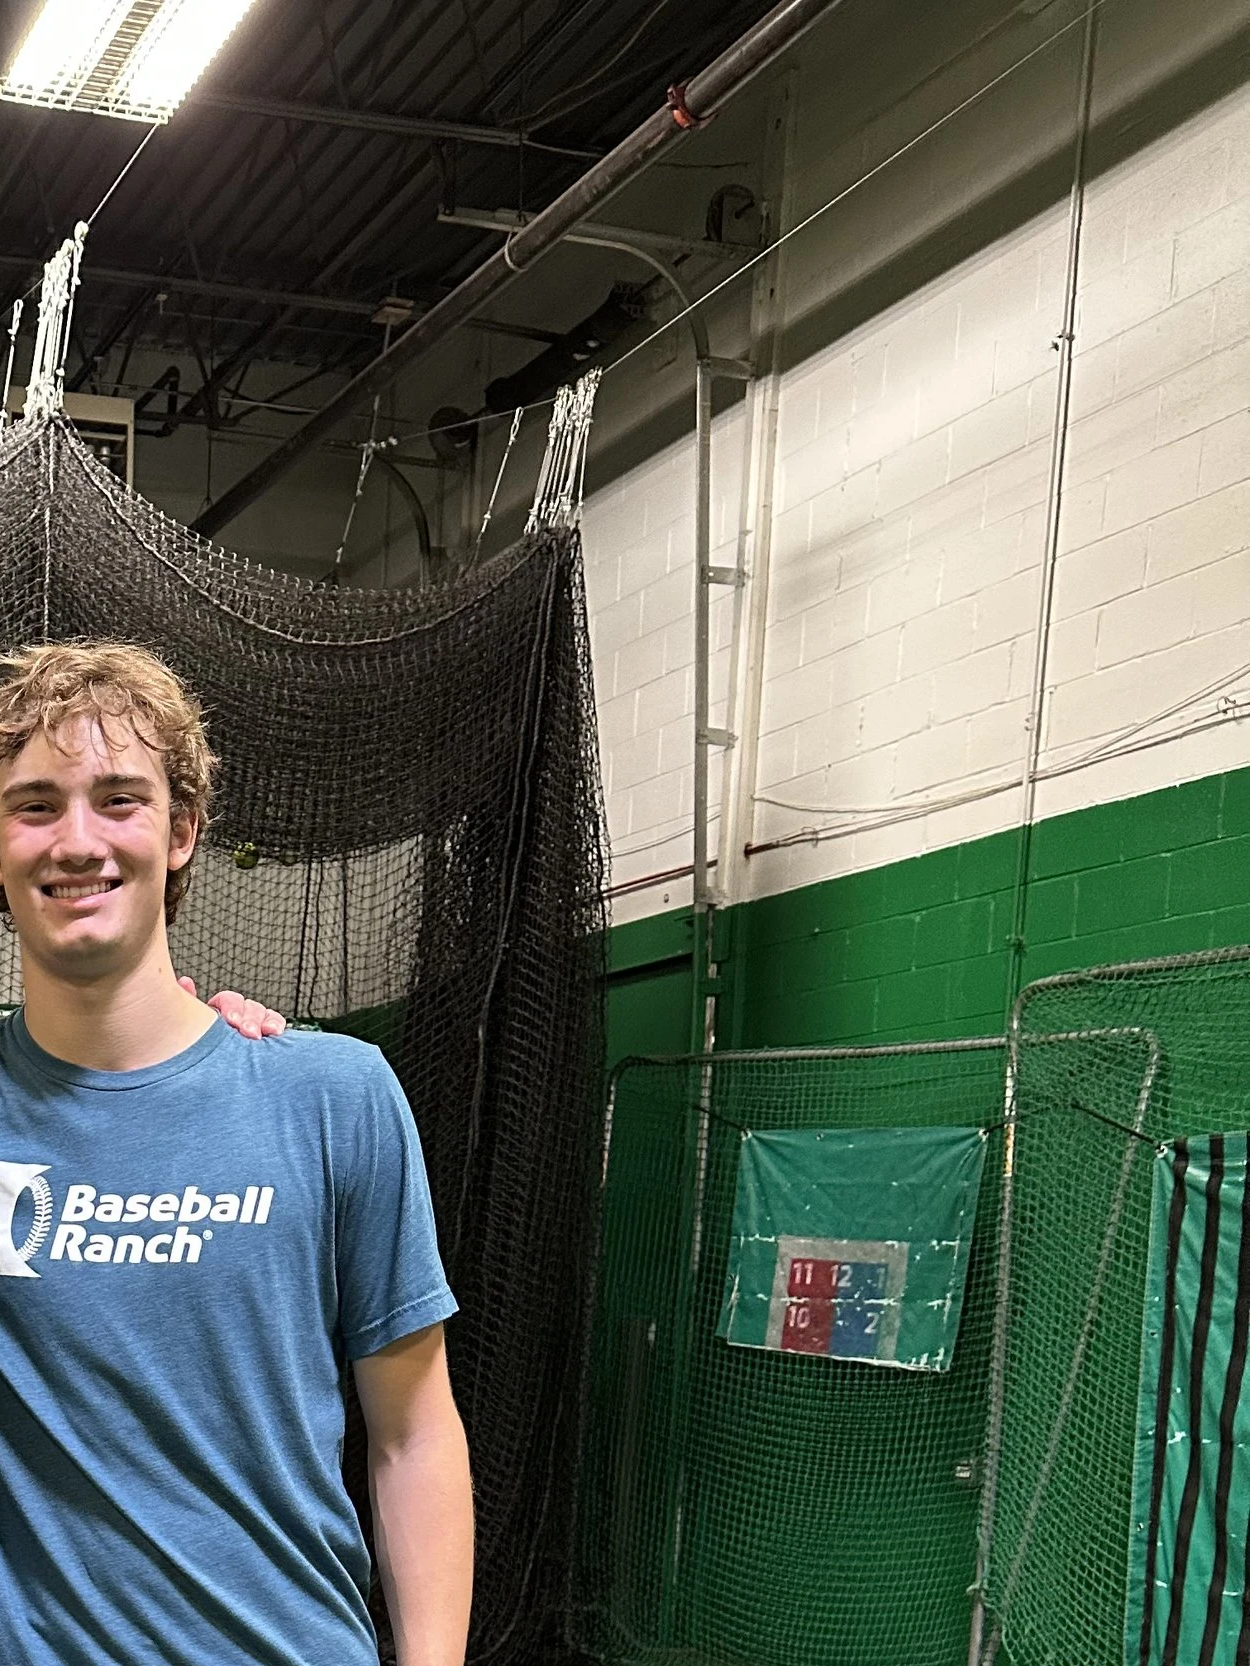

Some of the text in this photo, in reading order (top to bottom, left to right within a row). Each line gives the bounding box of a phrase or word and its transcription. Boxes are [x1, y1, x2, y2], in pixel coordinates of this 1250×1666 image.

[60, 1184, 275, 1225] Baseball
[792, 1262, 814, 1285] 11
[830, 1264, 854, 1287] 12
[787, 1305, 811, 1329] 10
[864, 1312, 880, 1334] 2
